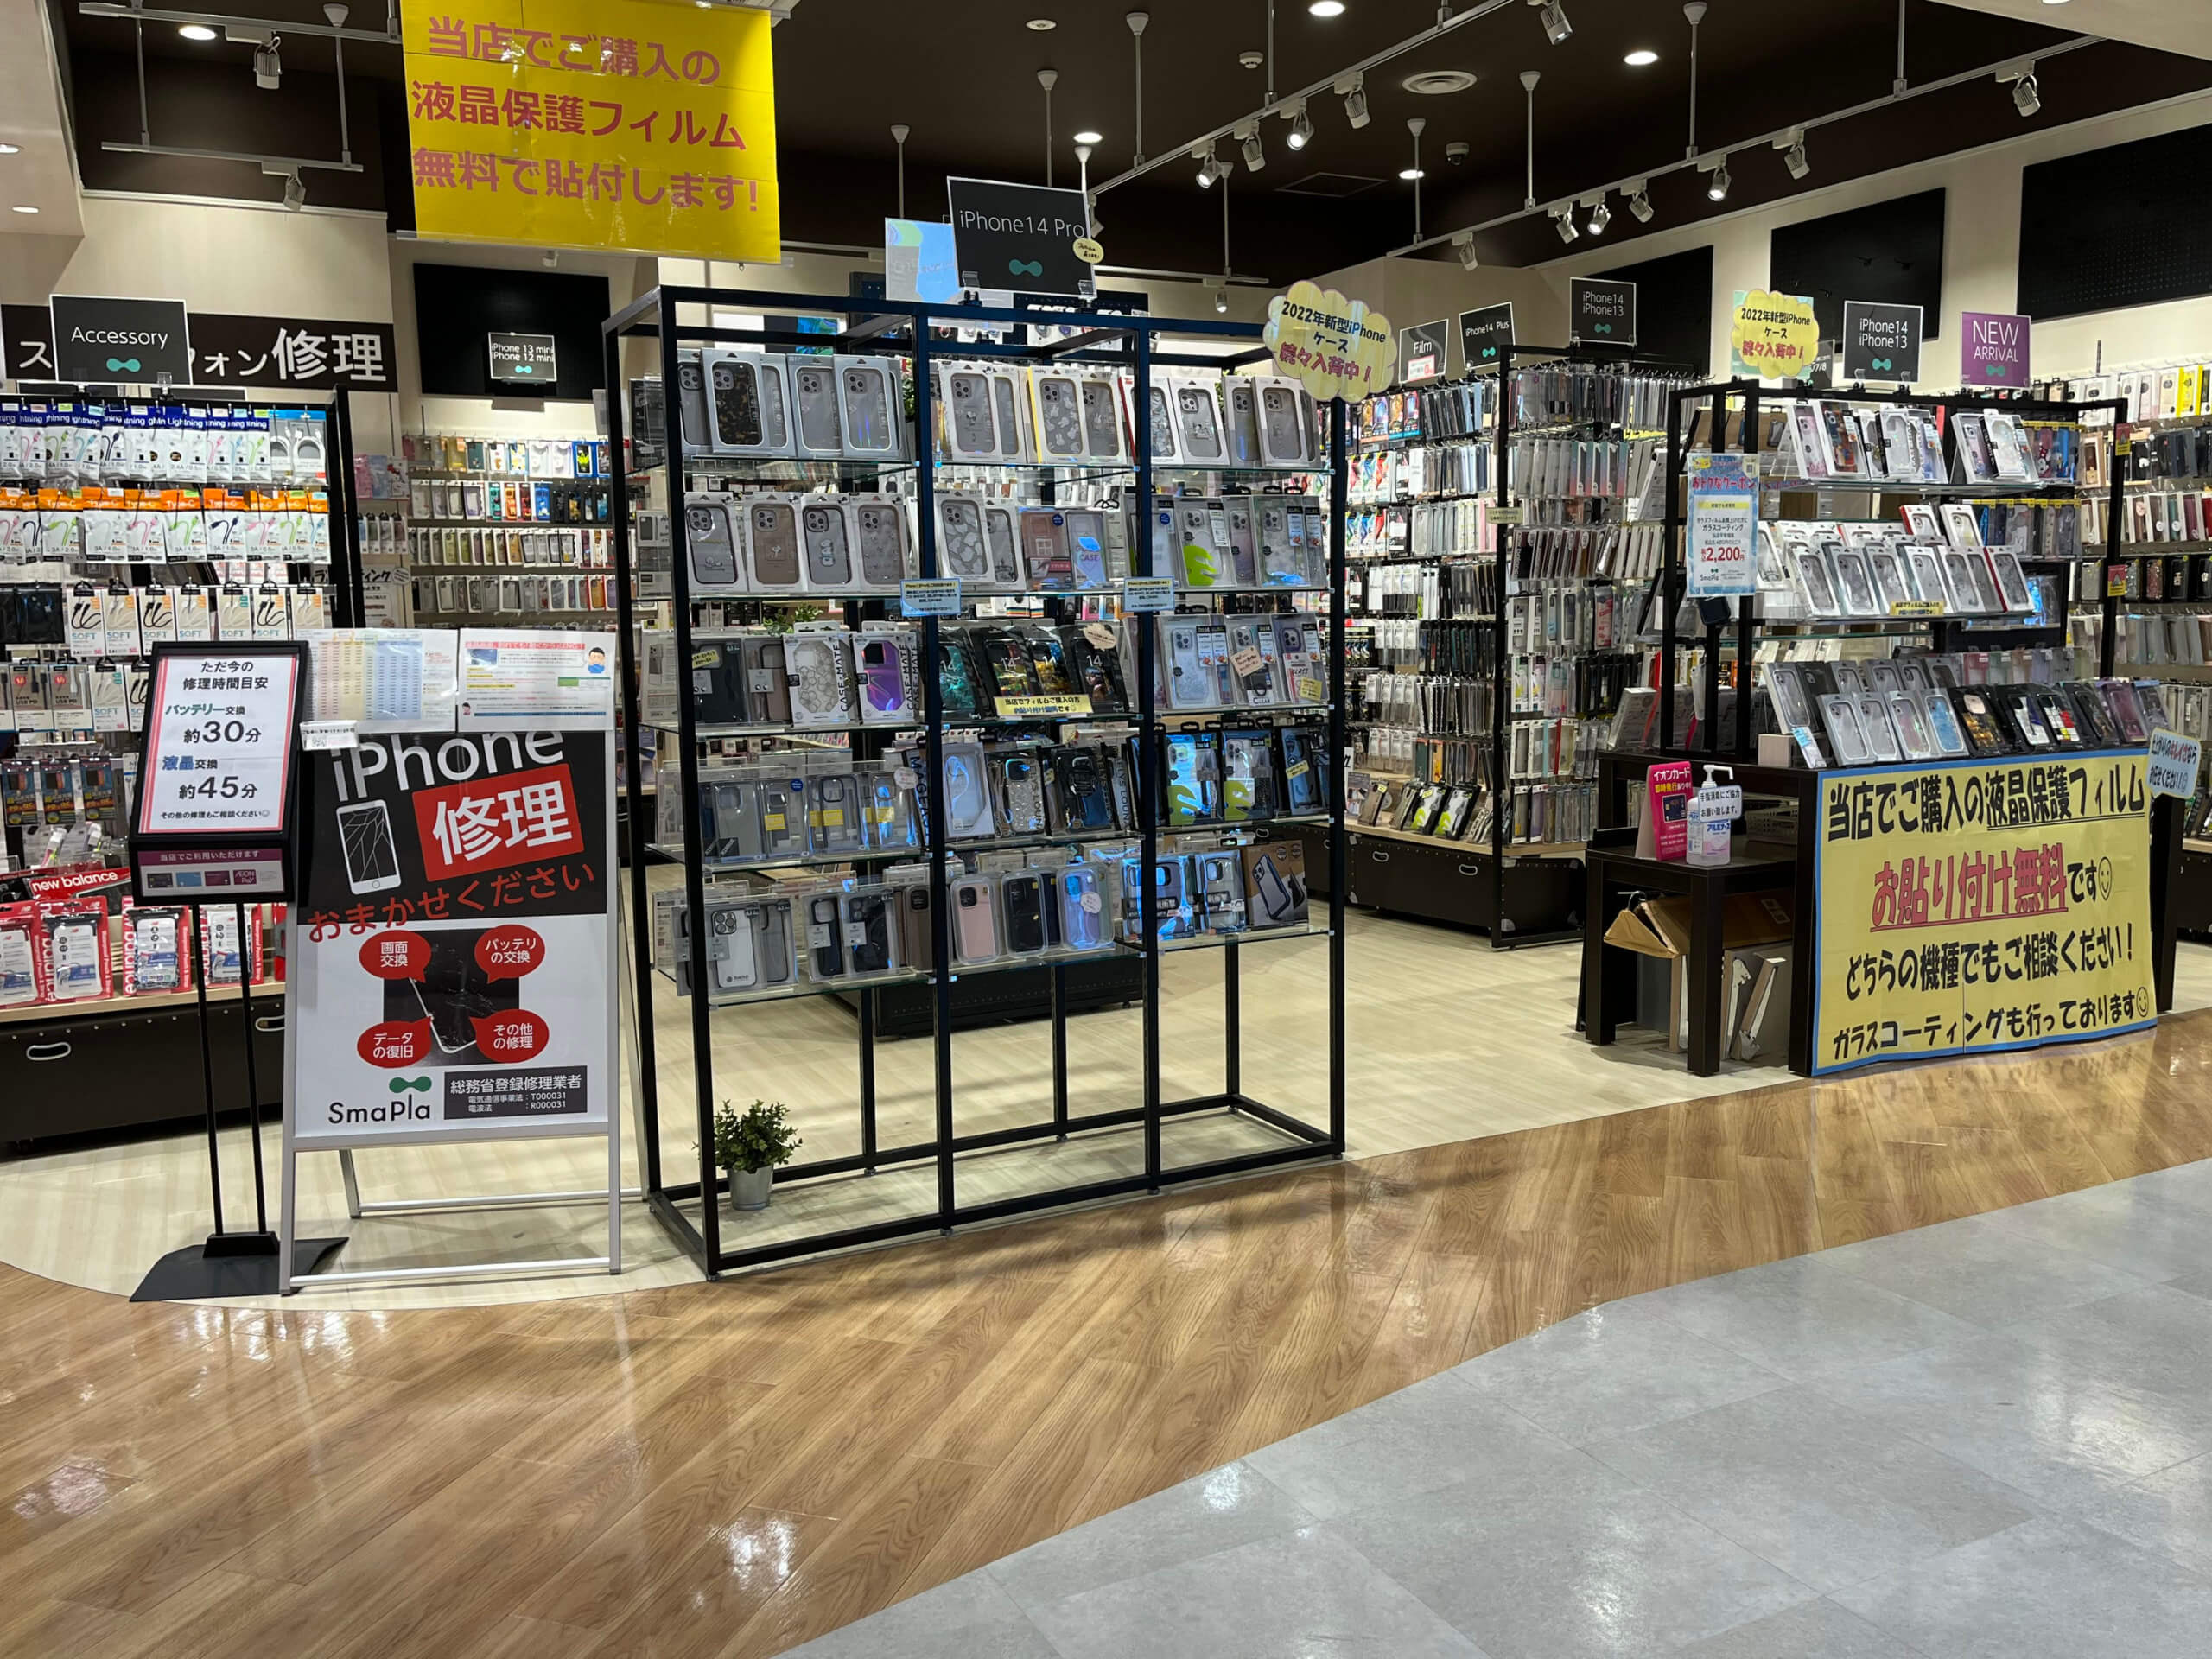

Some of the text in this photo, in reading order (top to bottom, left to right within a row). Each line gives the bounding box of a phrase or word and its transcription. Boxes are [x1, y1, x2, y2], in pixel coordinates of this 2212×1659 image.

[429, 16, 720, 85] 当店でご購入の
[411, 80, 746, 150] 液晶保護フィルム
[1055, 221, 1084, 238] Pro
[1281, 301, 1386, 344] 2022年新型iPhone
[1741, 308, 1811, 325] 2022年新型iPhone
[1497, 321, 1510, 330] Plus
[1764, 327, 1787, 339] ケース
[1973, 320, 2019, 346] NEW
[71, 327, 168, 350] Accessory
[1313, 333, 1349, 353] ケース
[491, 343, 520, 353] iPhone
[523, 345, 534, 353] 13
[1414, 341, 1432, 354] Film
[1974, 345, 2018, 364] ARRIVAL
[492, 352, 520, 361] iPhone
[524, 353, 534, 362] 12
[200, 661, 254, 672] ただ今の
[183, 677, 269, 690] 修理時間目安
[94, 707, 118, 715] SOFT
[165, 703, 245, 715] バッテリー交換
[183, 720, 262, 743] 約30分
[162, 755, 218, 770] 液晶交換
[330, 731, 566, 802] iPhone
[1654, 767, 1690, 781] イオンカード
[179, 776, 257, 799] 約45分
[1827, 764, 2145, 842] 当店でご購入の液晶保護フィルム
[432, 779, 573, 865] 修理
[31, 870, 118, 893] new balance
[1872, 842, 2098, 926] お貼り付け無料です
[308, 864, 595, 943] おまかせください
[380, 941, 408, 954] 画面
[486, 938, 537, 951] バッテリ
[380, 954, 409, 968] 交換
[491, 950, 531, 964] の交換
[493, 1023, 533, 1037] その他
[1834, 990, 2135, 1060] ガラスコーティングも行っております
[373, 1033, 414, 1046] データ
[493, 1035, 533, 1050] の修理
[373, 1044, 413, 1059] の復旧
[450, 1074, 582, 1095] 総務省登録修理業者
[328, 1094, 431, 1124] SmaPla
